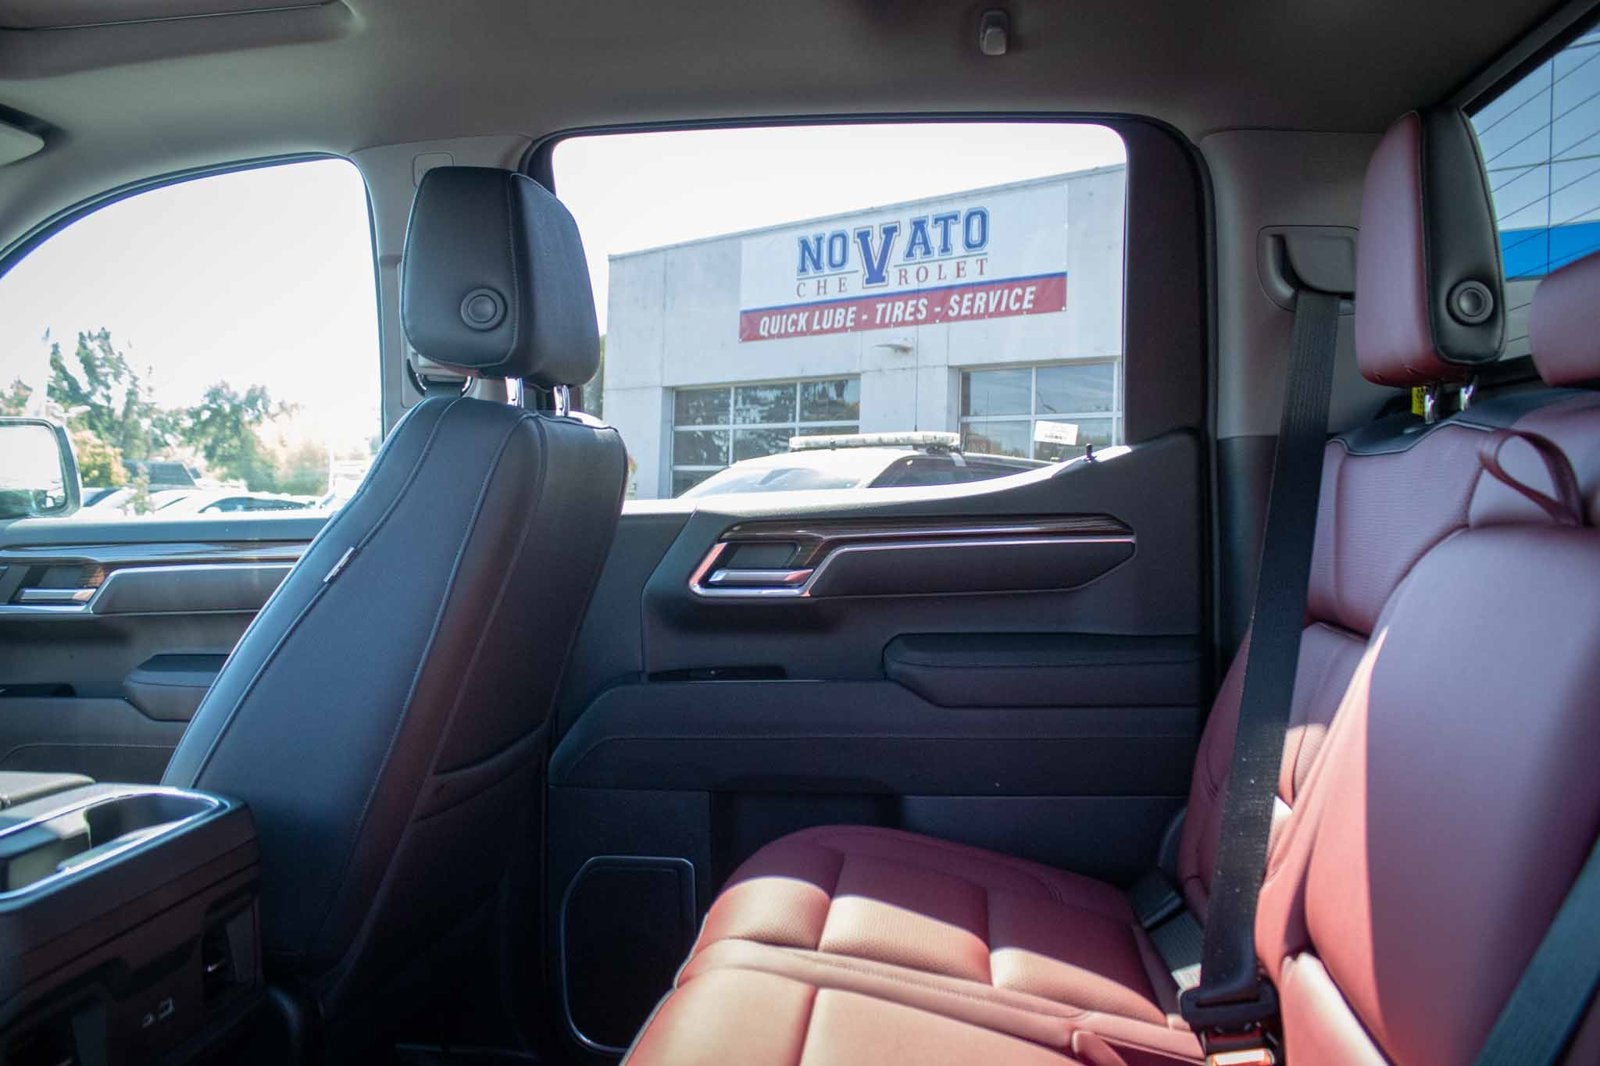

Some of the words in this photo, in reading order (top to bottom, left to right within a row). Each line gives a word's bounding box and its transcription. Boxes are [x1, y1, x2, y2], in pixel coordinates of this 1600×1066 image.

[797, 207, 989, 288] NOVATO
[759, 312, 807, 336] QUICK
[812, 306, 856, 329] LUBE
[875, 298, 928, 324] TIRES
[948, 286, 1035, 317] SERVICE
